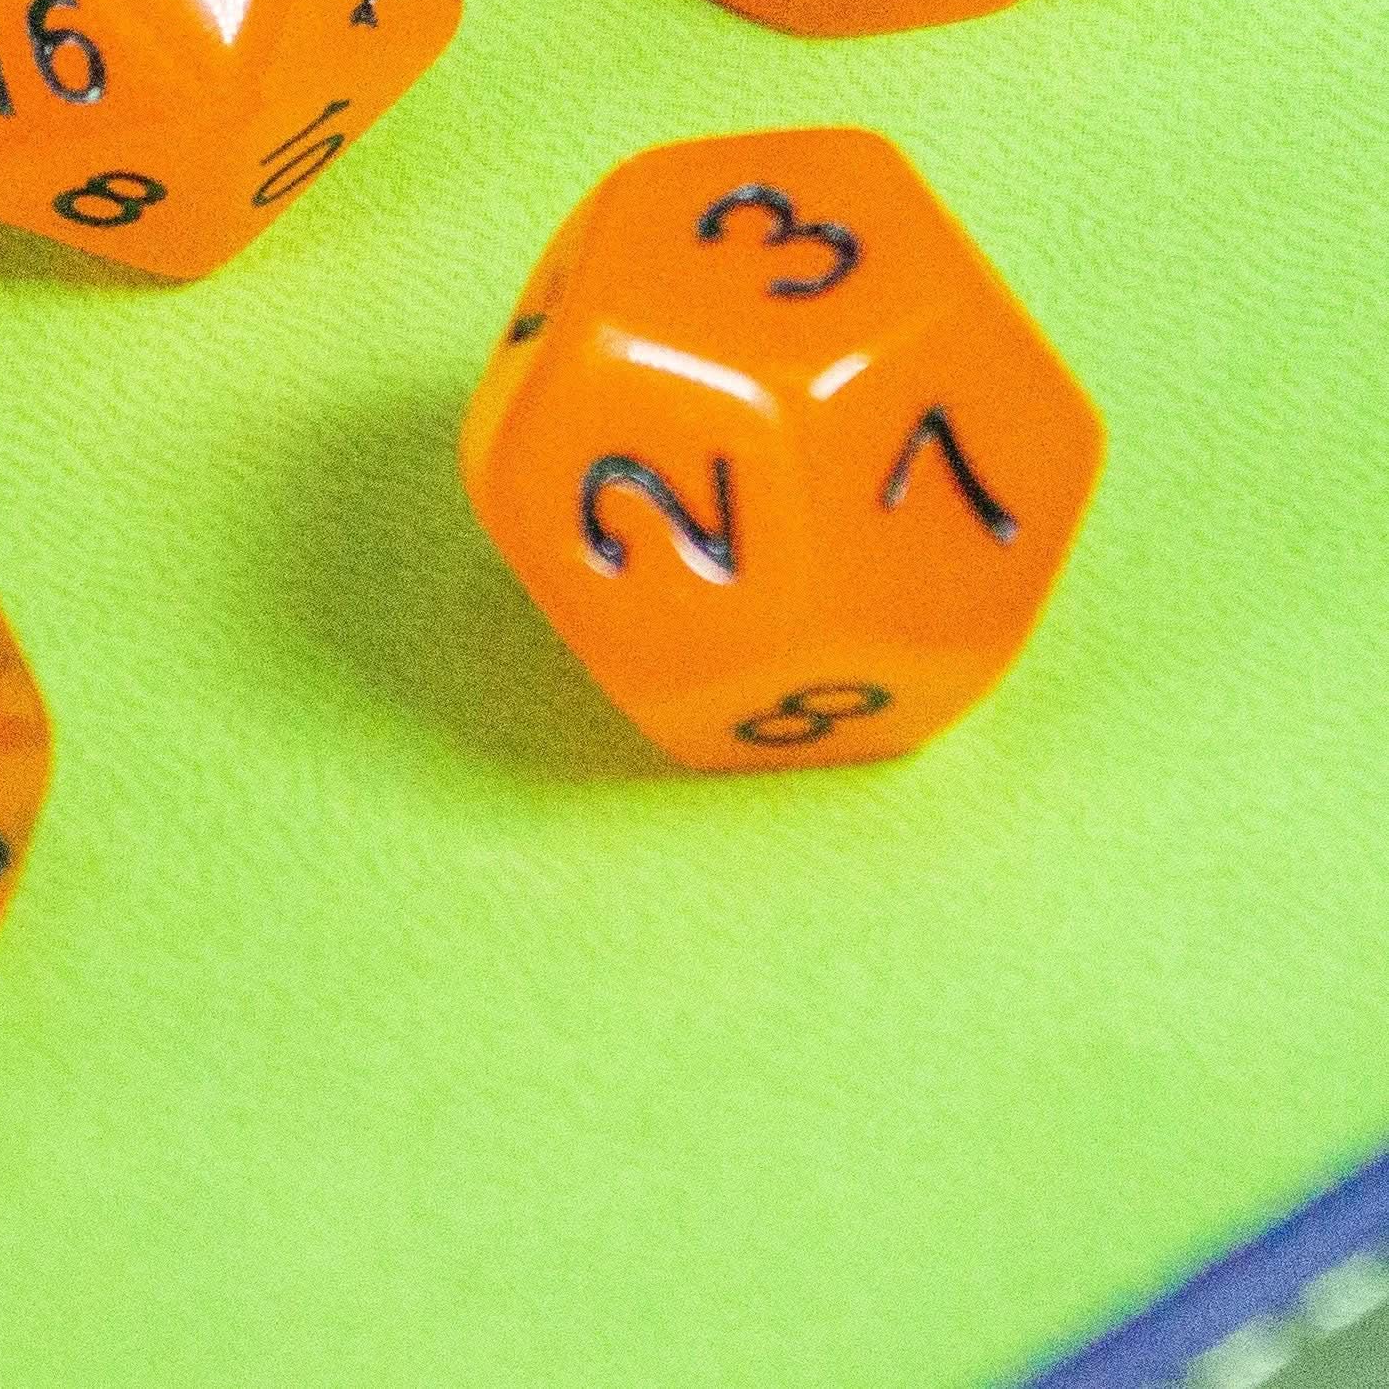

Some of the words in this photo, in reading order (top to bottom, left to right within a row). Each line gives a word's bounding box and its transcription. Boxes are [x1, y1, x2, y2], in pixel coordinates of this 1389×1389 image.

[52, 169, 168, 228] 8
[251, 99, 353, 207] 10
[694, 182, 866, 298] 3
[576, 453, 738, 586] 2
[879, 404, 1020, 545] 7
[733, 679, 894, 748] 8
